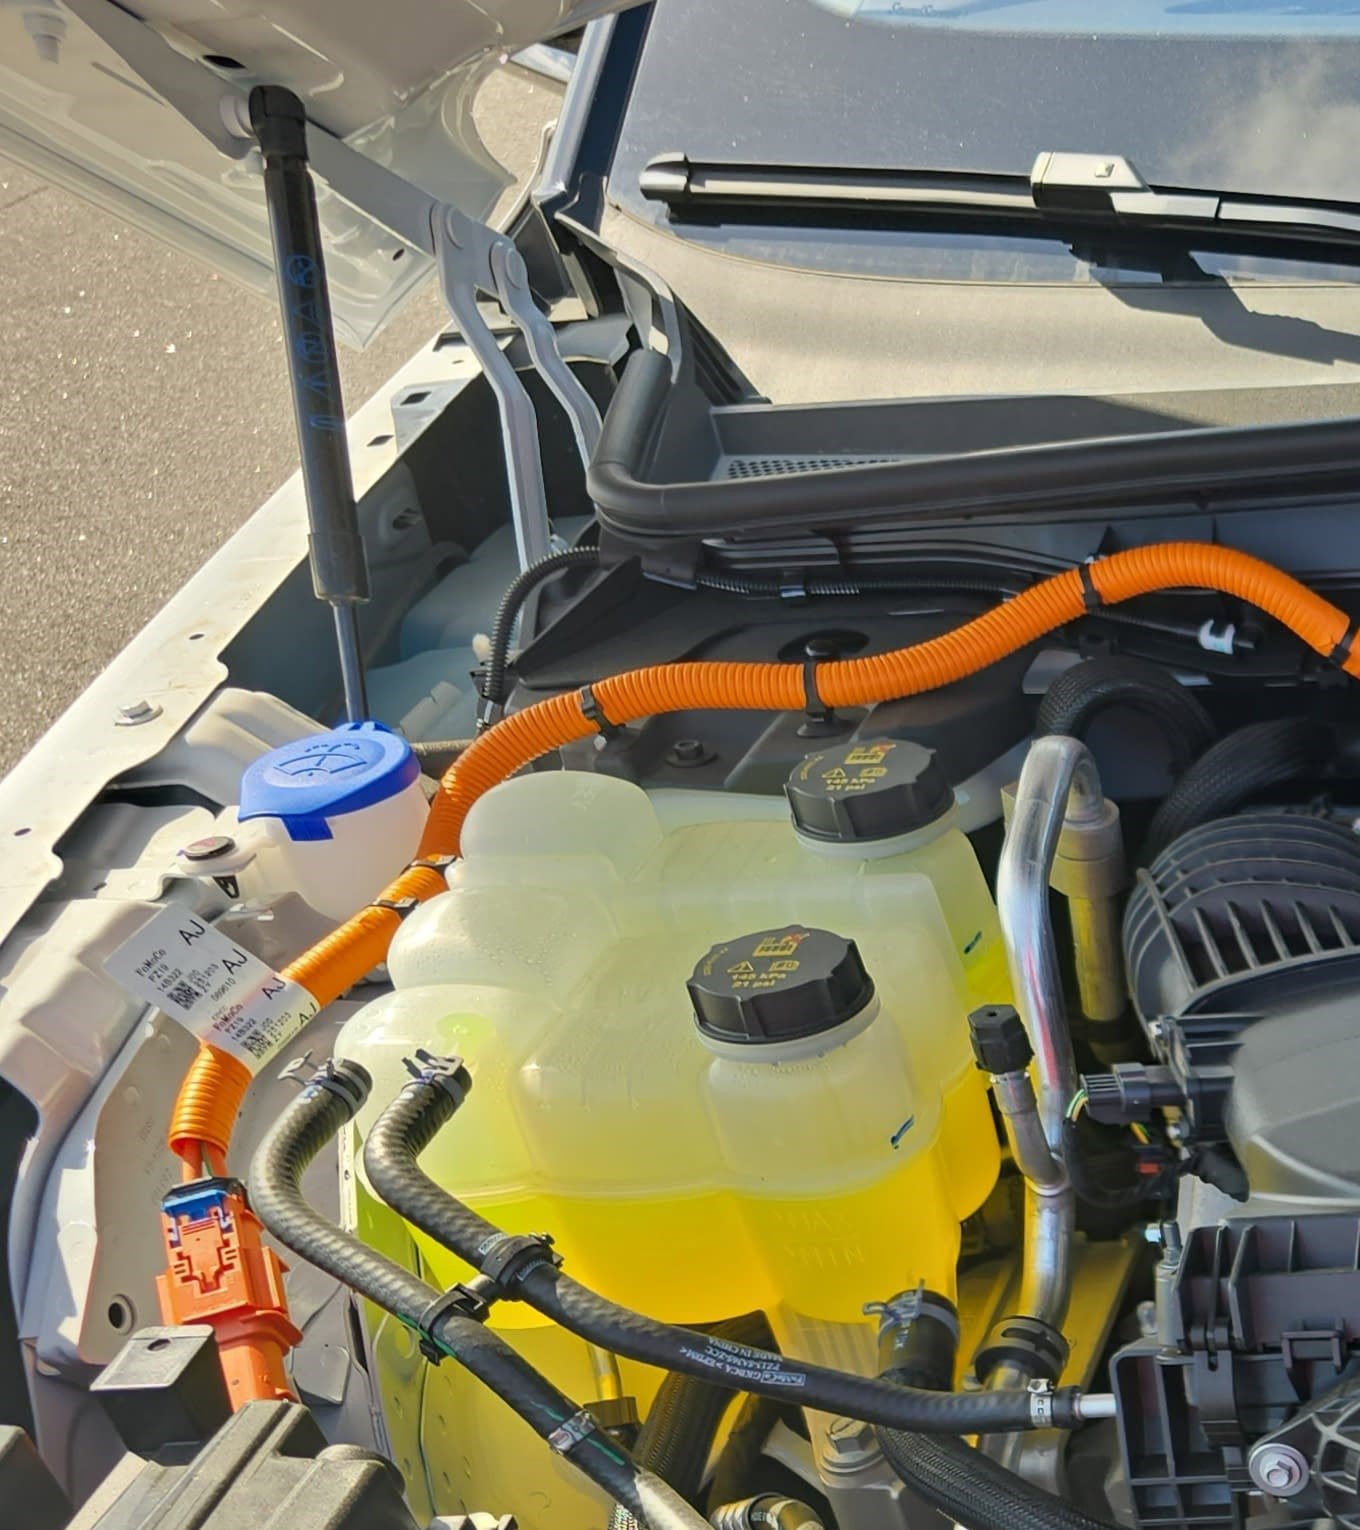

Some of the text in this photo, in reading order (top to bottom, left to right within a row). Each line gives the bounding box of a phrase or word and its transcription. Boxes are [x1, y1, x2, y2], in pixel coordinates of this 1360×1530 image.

[178, 919, 206, 946] AJ
[221, 948, 248, 975] AJ
[261, 977, 286, 1000] AJ
